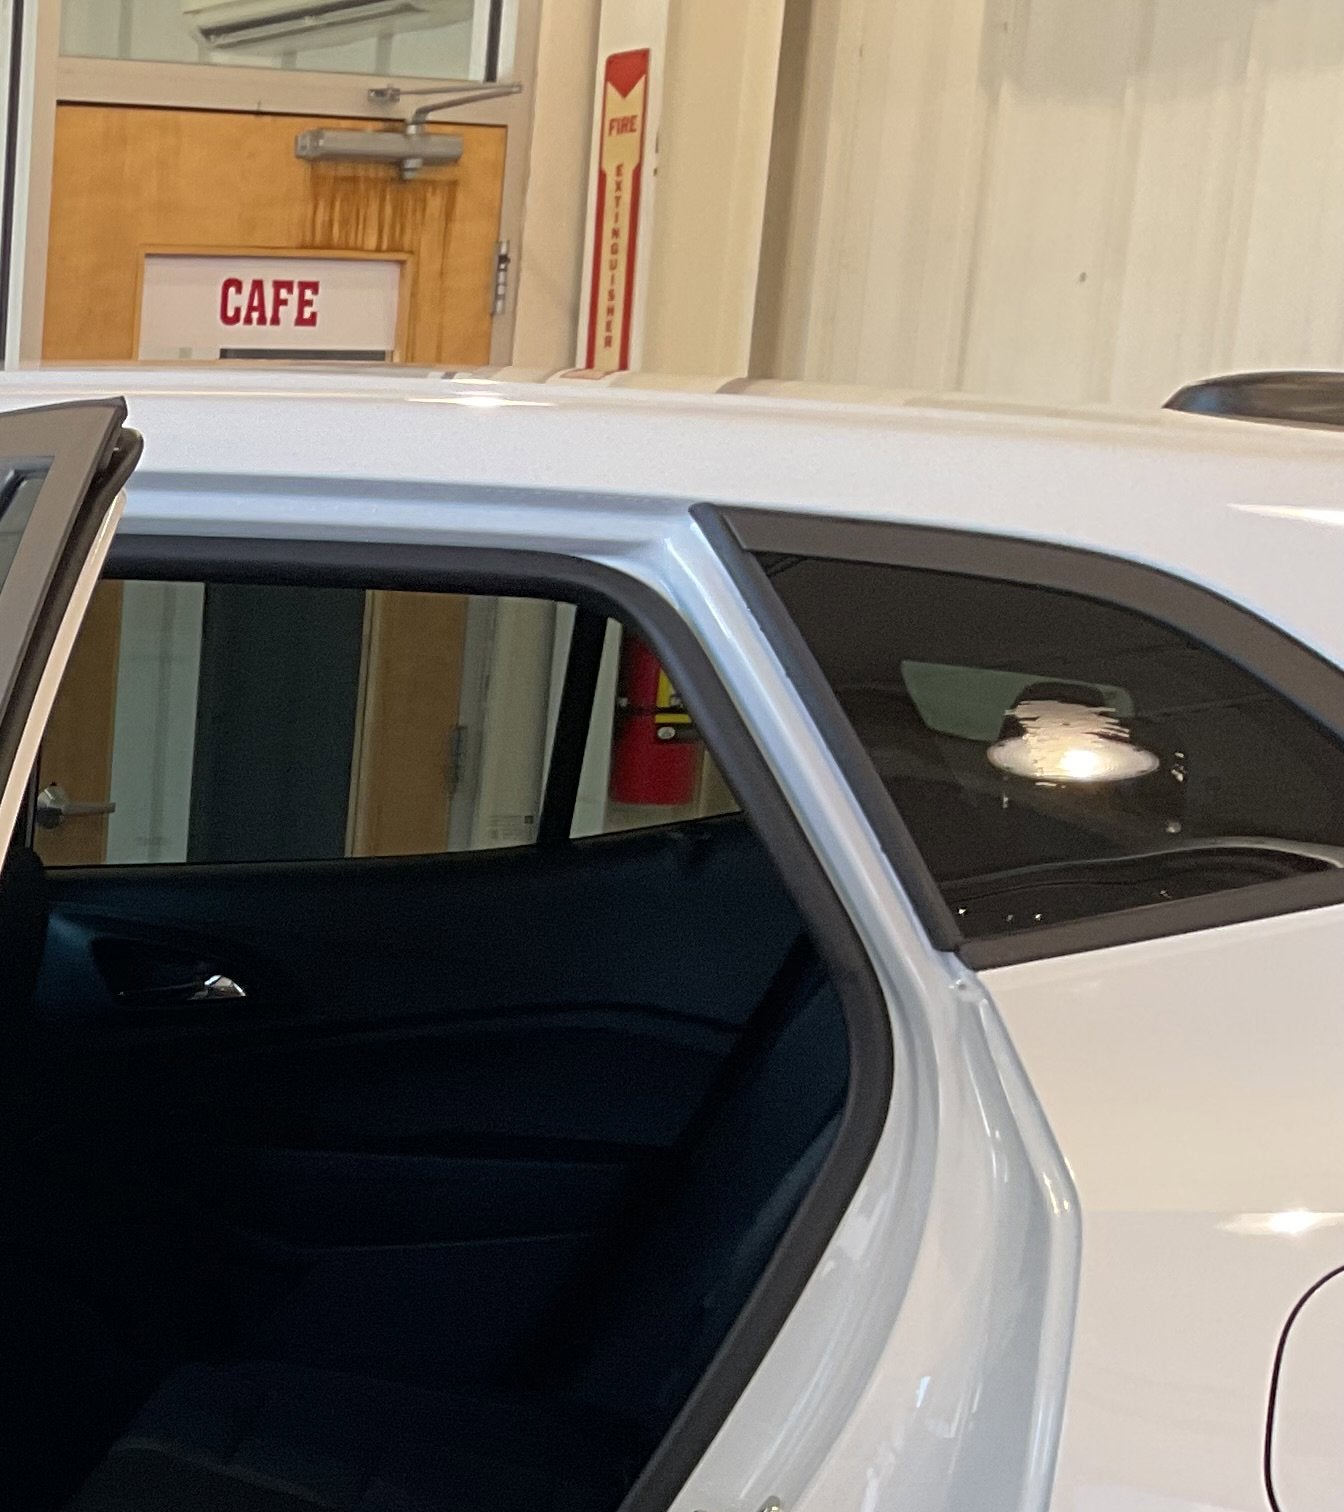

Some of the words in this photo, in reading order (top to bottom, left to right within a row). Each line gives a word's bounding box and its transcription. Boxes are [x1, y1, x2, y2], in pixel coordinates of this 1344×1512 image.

[608, 115, 639, 136] FIRE
[604, 163, 624, 349] EXTINGUISHER
[220, 277, 320, 327] CAFE
